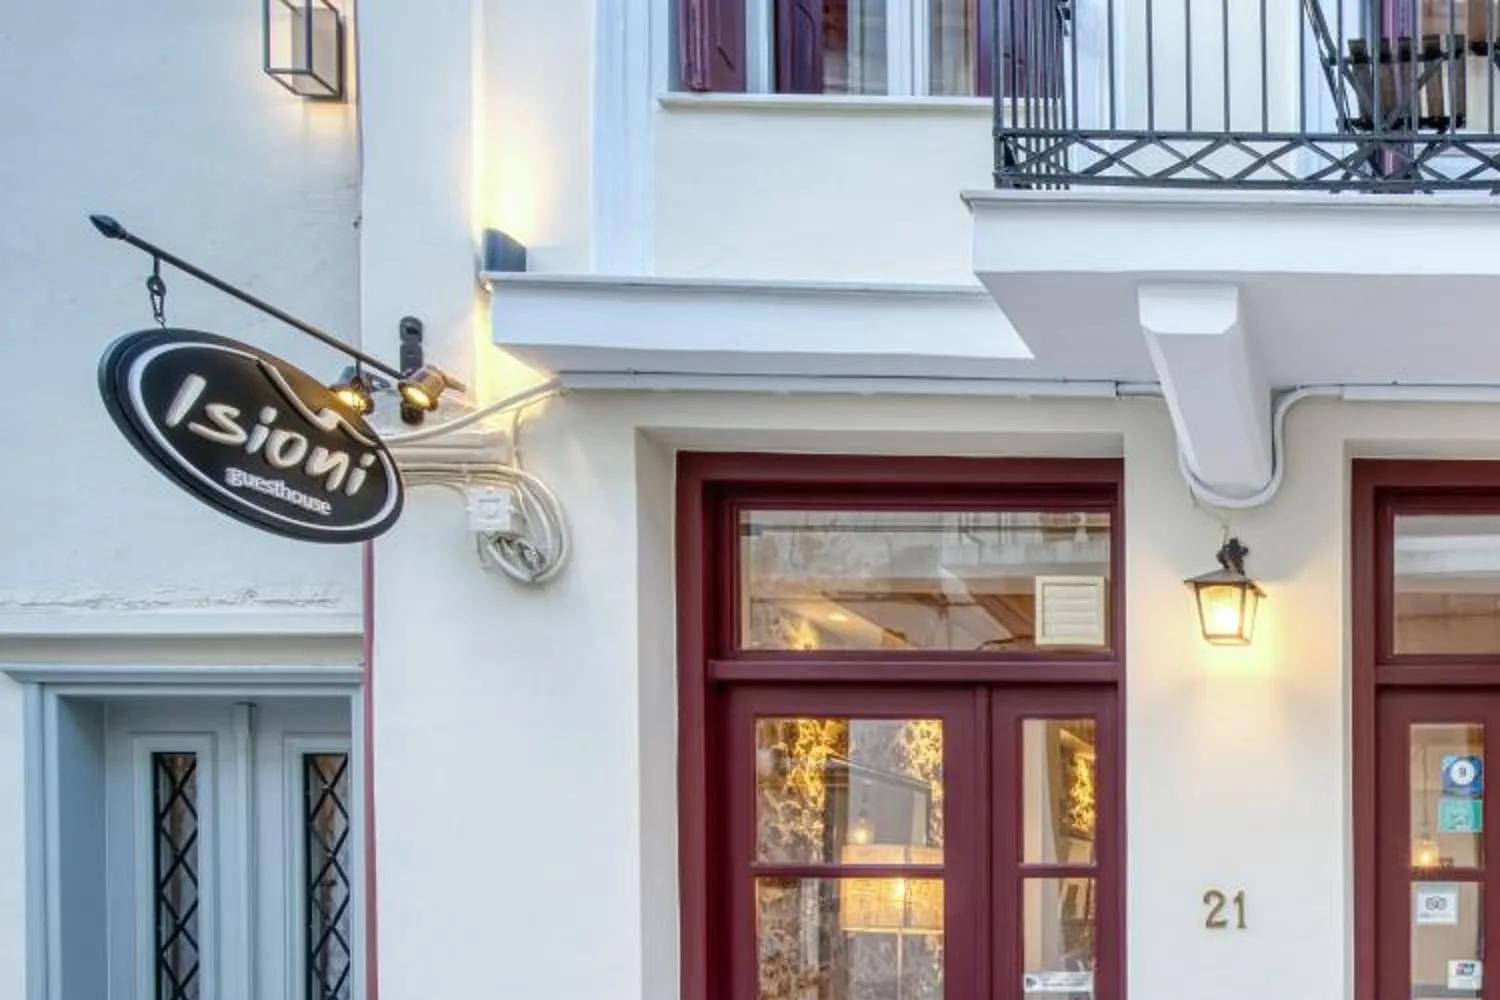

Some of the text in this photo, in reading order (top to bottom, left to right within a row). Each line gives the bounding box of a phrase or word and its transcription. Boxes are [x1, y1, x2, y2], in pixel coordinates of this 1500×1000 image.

[166, 374, 376, 496] Isioni
[225, 467, 332, 515] guesthouse
[1203, 889, 1247, 929] 21
